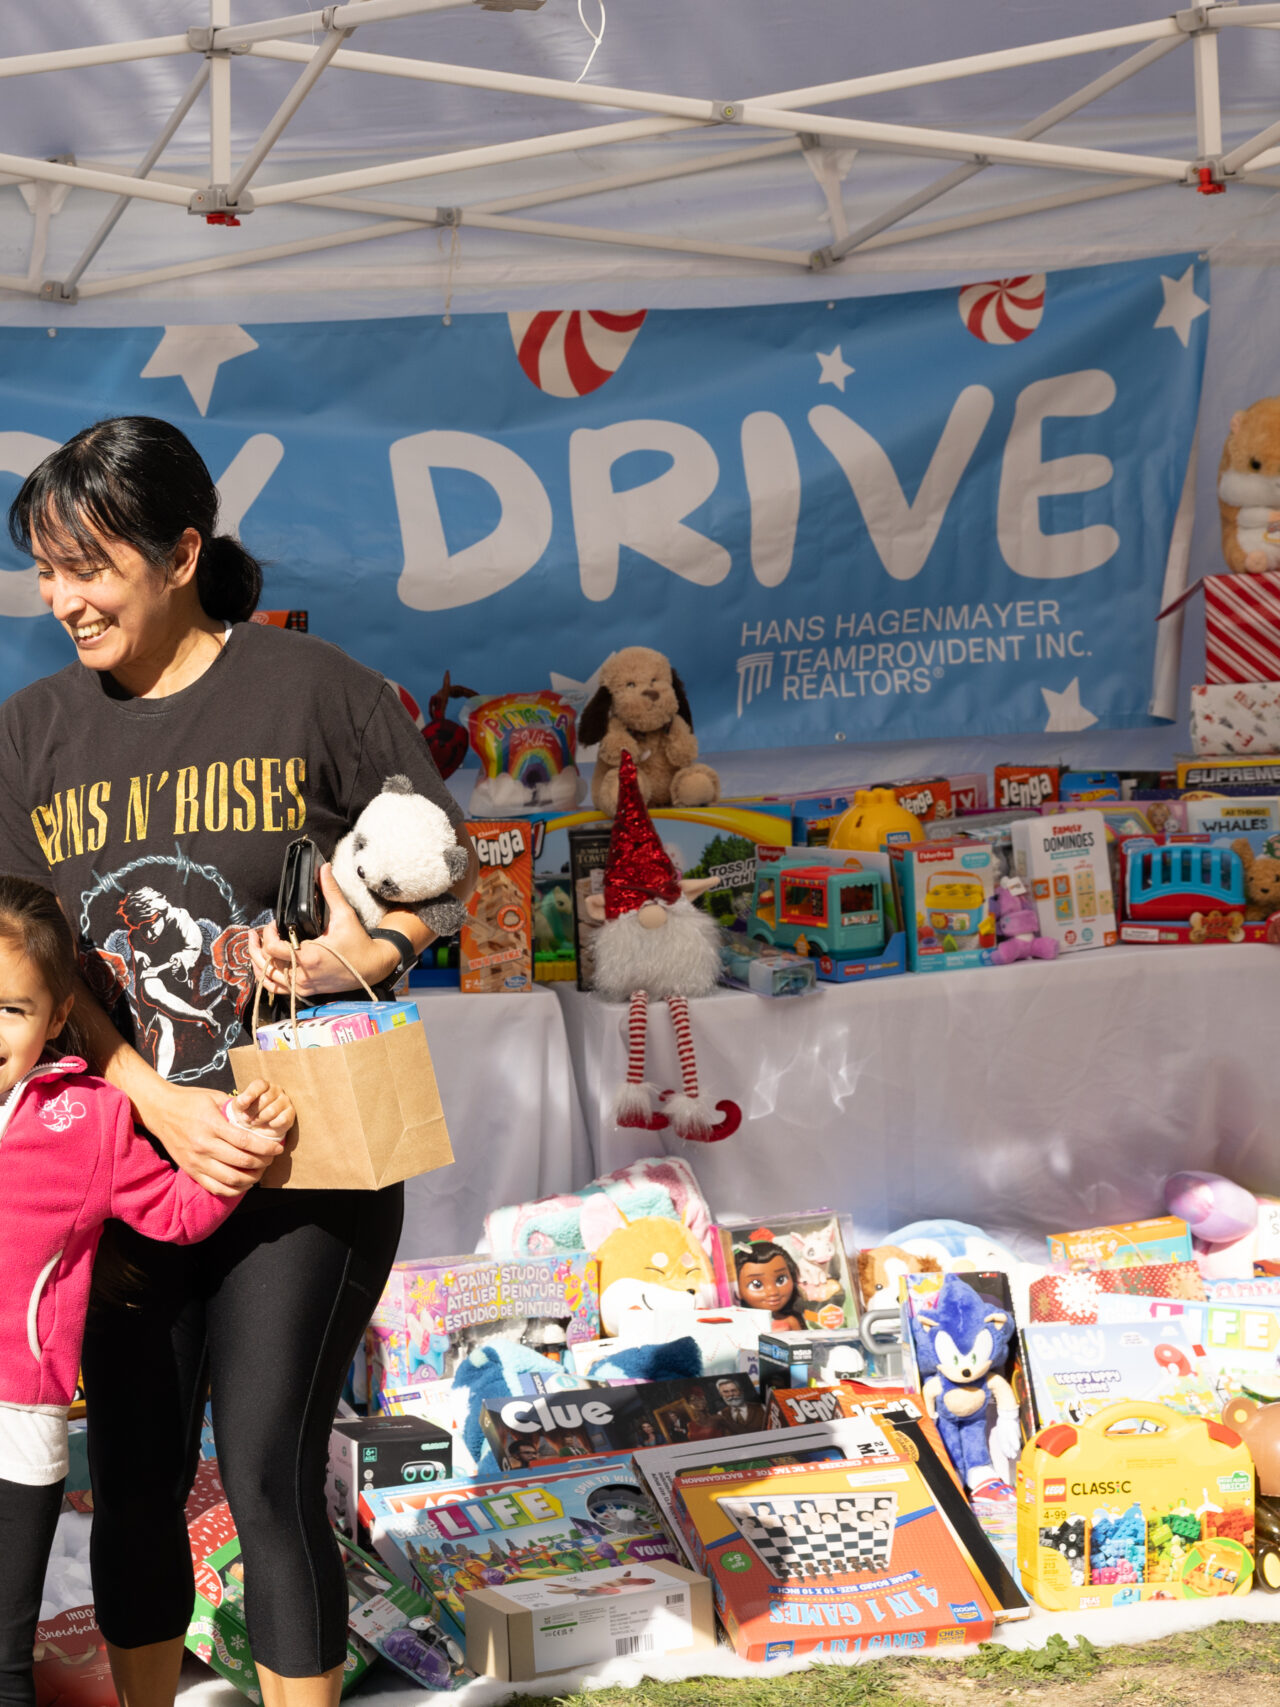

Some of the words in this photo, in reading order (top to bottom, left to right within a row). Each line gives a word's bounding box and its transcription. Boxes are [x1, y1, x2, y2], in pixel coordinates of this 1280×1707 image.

[389, 369, 1119, 612] DRIVE
[740, 615, 825, 647] HANS
[835, 600, 1061, 639] HAGENMAYER
[780, 635, 1025, 675] TEAMPROVIDENT
[1036, 630, 1093, 659] INC.
[899, 789, 934, 816] Jenga
[998, 773, 1053, 809] Jenga
[1052, 824, 1082, 835] FAMILY
[1202, 818, 1269, 833] WHALES
[1043, 832, 1095, 853] DOMINOES
[710, 861, 746, 877] TOSS
[709, 873, 751, 892] ATCH
[457, 1268, 498, 1291] PAINT
[500, 1264, 551, 1283] STUDIO
[446, 1286, 498, 1312] ATELIER
[500, 1283, 565, 1299] PEINTURE
[444, 1305, 499, 1332] ESTUDIO
[514, 1299, 570, 1318] PINTURA
[571, 1322, 587, 1334] 24
[421, 1366, 429, 1379] 6
[500, 1397, 615, 1433] Clue
[785, 1388, 845, 1424] Jen
[574, 1478, 593, 1496] SPIN
[594, 1475, 611, 1485] TO
[681, 1472, 744, 1484] BACKGAMMON
[1044, 1484, 1066, 1496] LEGO
[435, 1491, 558, 1538] LIFE
[1043, 1510, 1067, 1521] 4-99
[885, 1590, 924, 1619] IN
[915, 1585, 939, 1607] 4
[769, 1600, 862, 1626] GAMES
[865, 1598, 886, 1623] 1
[867, 1630, 927, 1650] GAMES
[938, 1628, 965, 1638] CHESS
